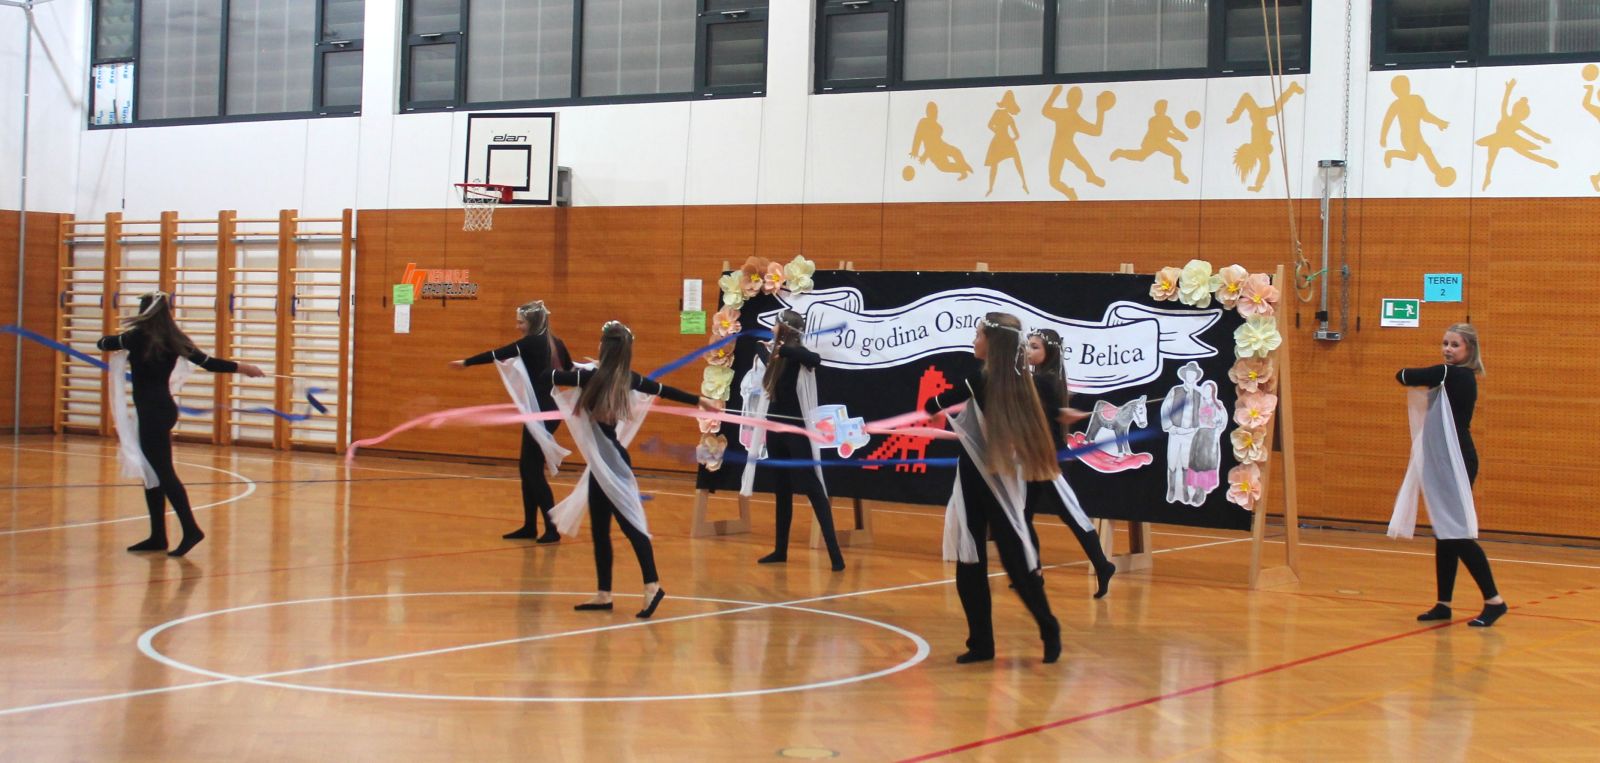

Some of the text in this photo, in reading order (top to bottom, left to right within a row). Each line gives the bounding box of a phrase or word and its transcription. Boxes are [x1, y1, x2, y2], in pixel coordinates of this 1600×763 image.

[492, 133, 528, 143] elan
[1428, 276, 1458, 285] TEREN
[1440, 288, 1446, 296] 2
[832, 328, 856, 349] 30
[860, 325, 929, 358] godina
[1079, 343, 1145, 367] Belica
